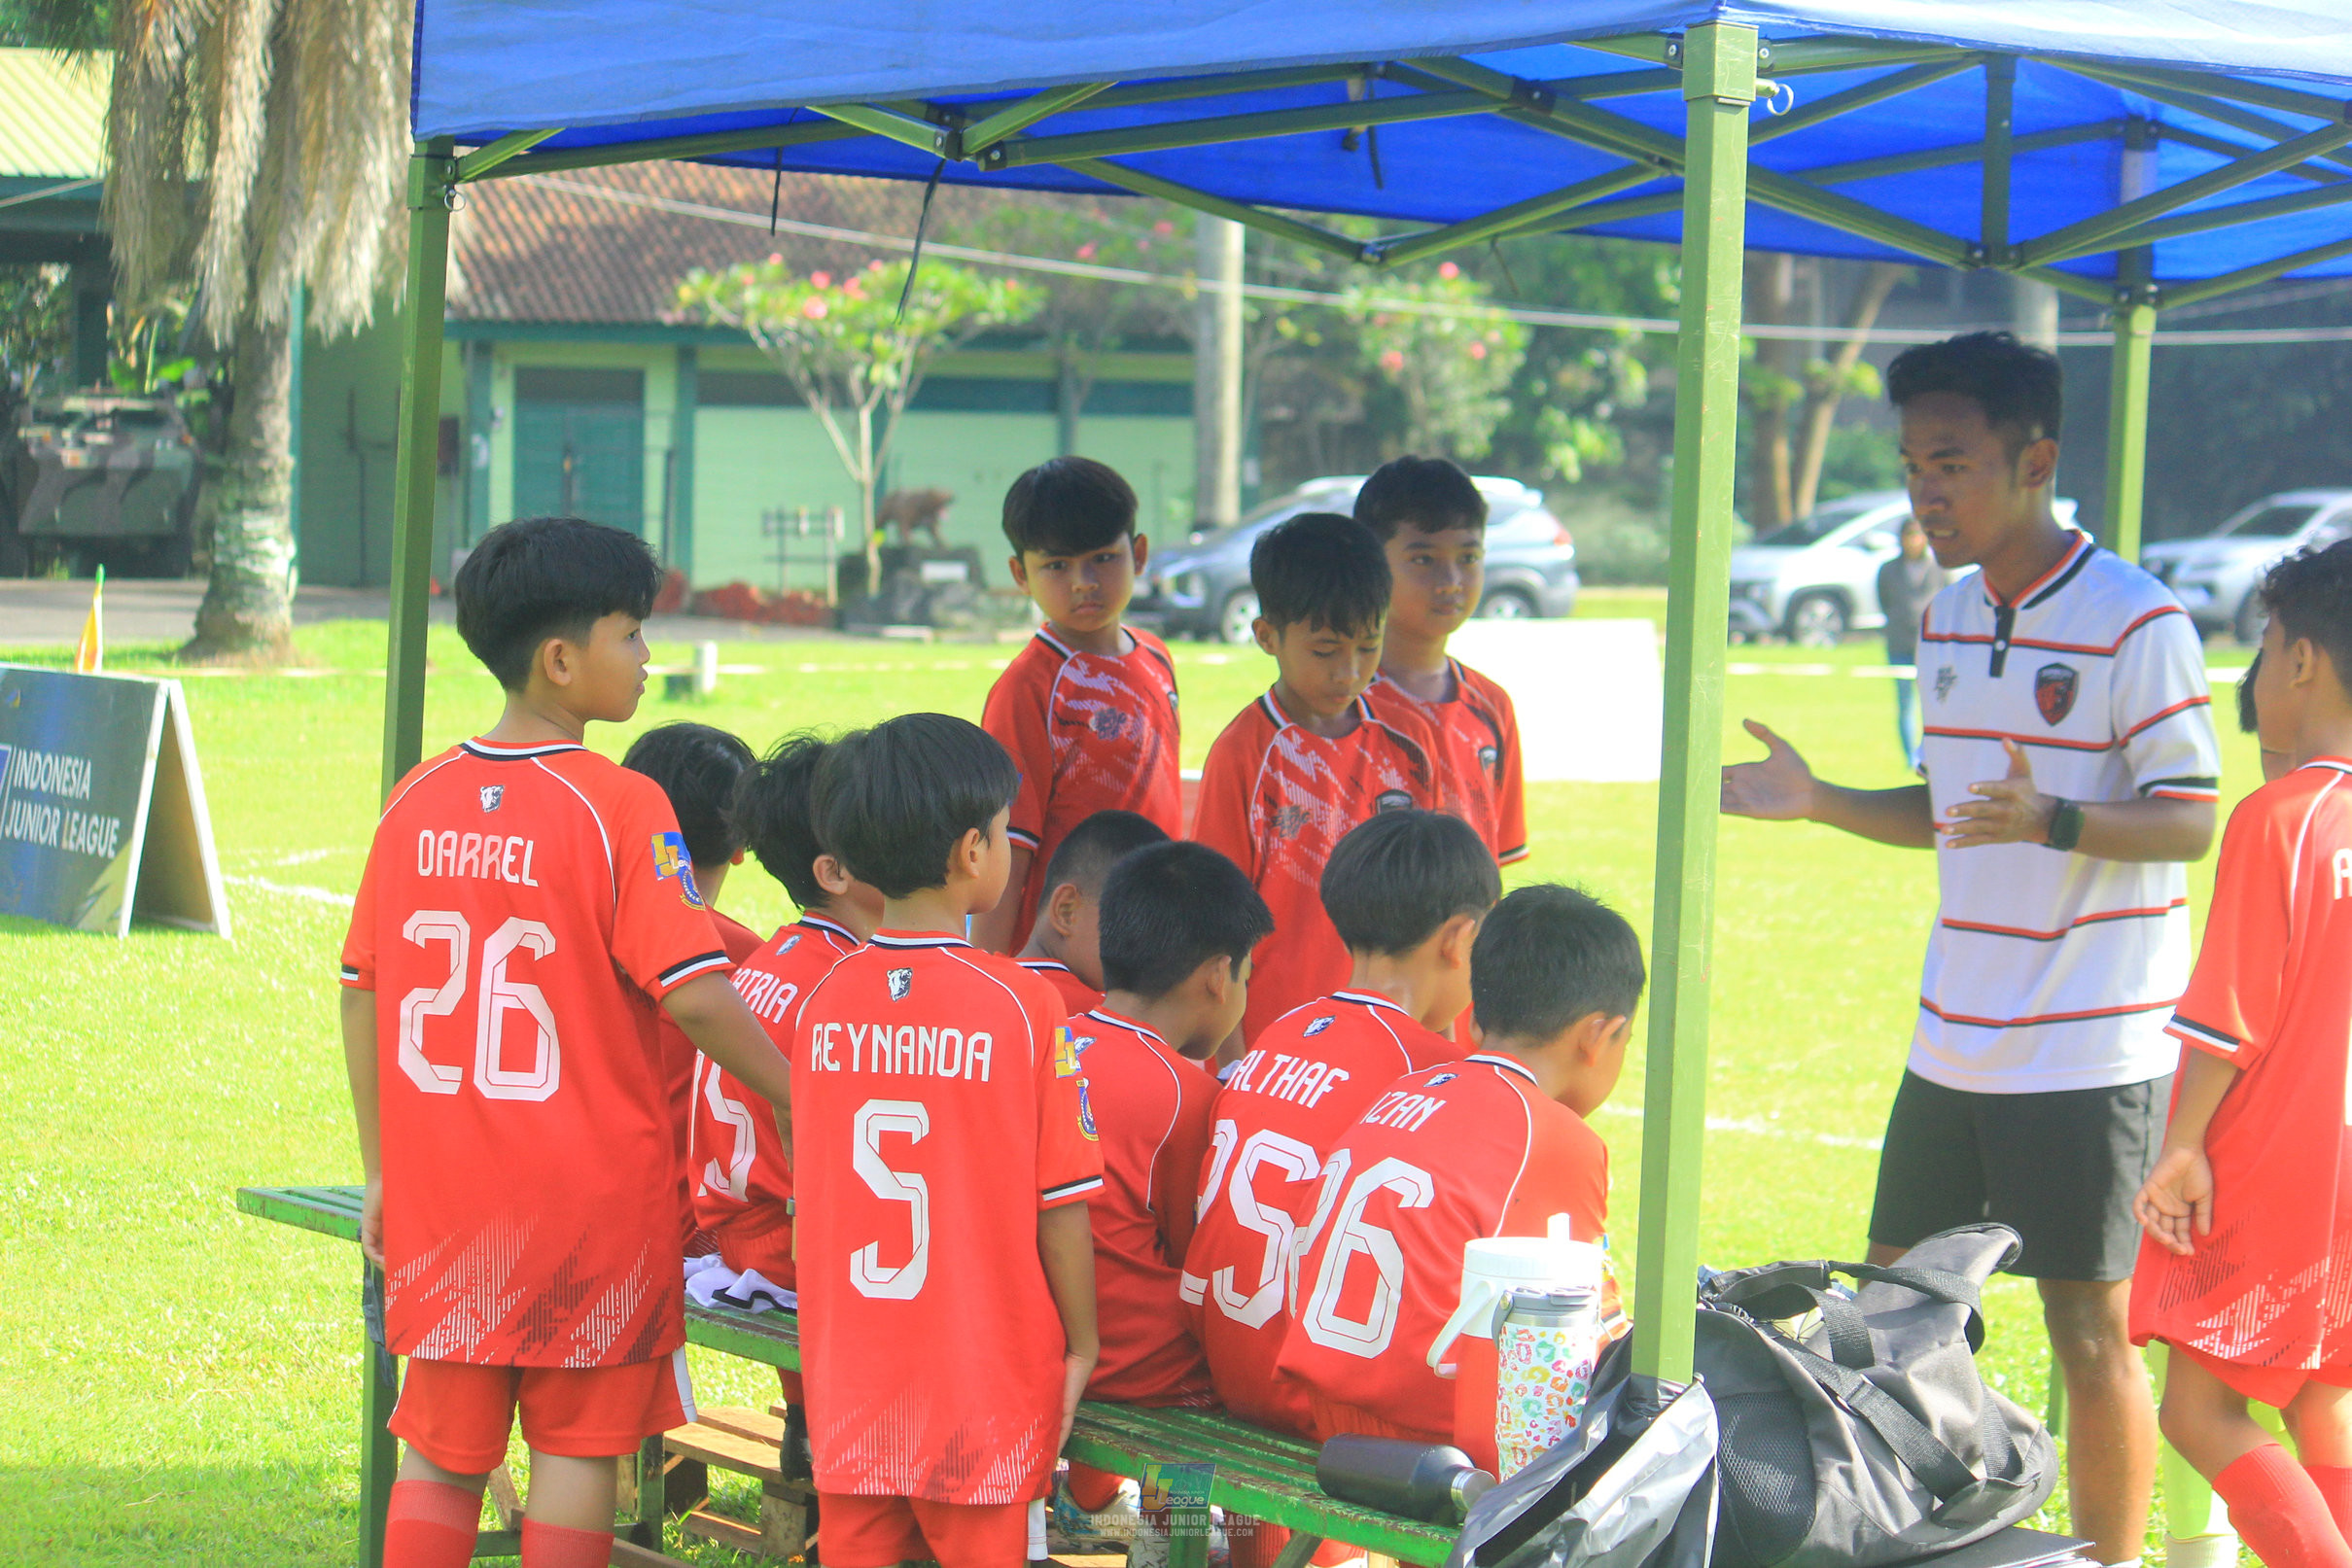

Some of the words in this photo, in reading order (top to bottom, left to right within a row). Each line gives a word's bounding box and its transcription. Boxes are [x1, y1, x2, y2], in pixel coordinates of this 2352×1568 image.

[13, 749, 91, 801] INDONESIA
[5, 798, 61, 846] JUNIOR
[62, 808, 121, 859] LEAGUE
[417, 829, 539, 887] DARREL
[398, 909, 561, 1102] 26
[811, 1022, 993, 1082] REYNANDA
[1224, 1050, 1351, 1109] ALTHAF
[850, 1098, 930, 1301] 5
